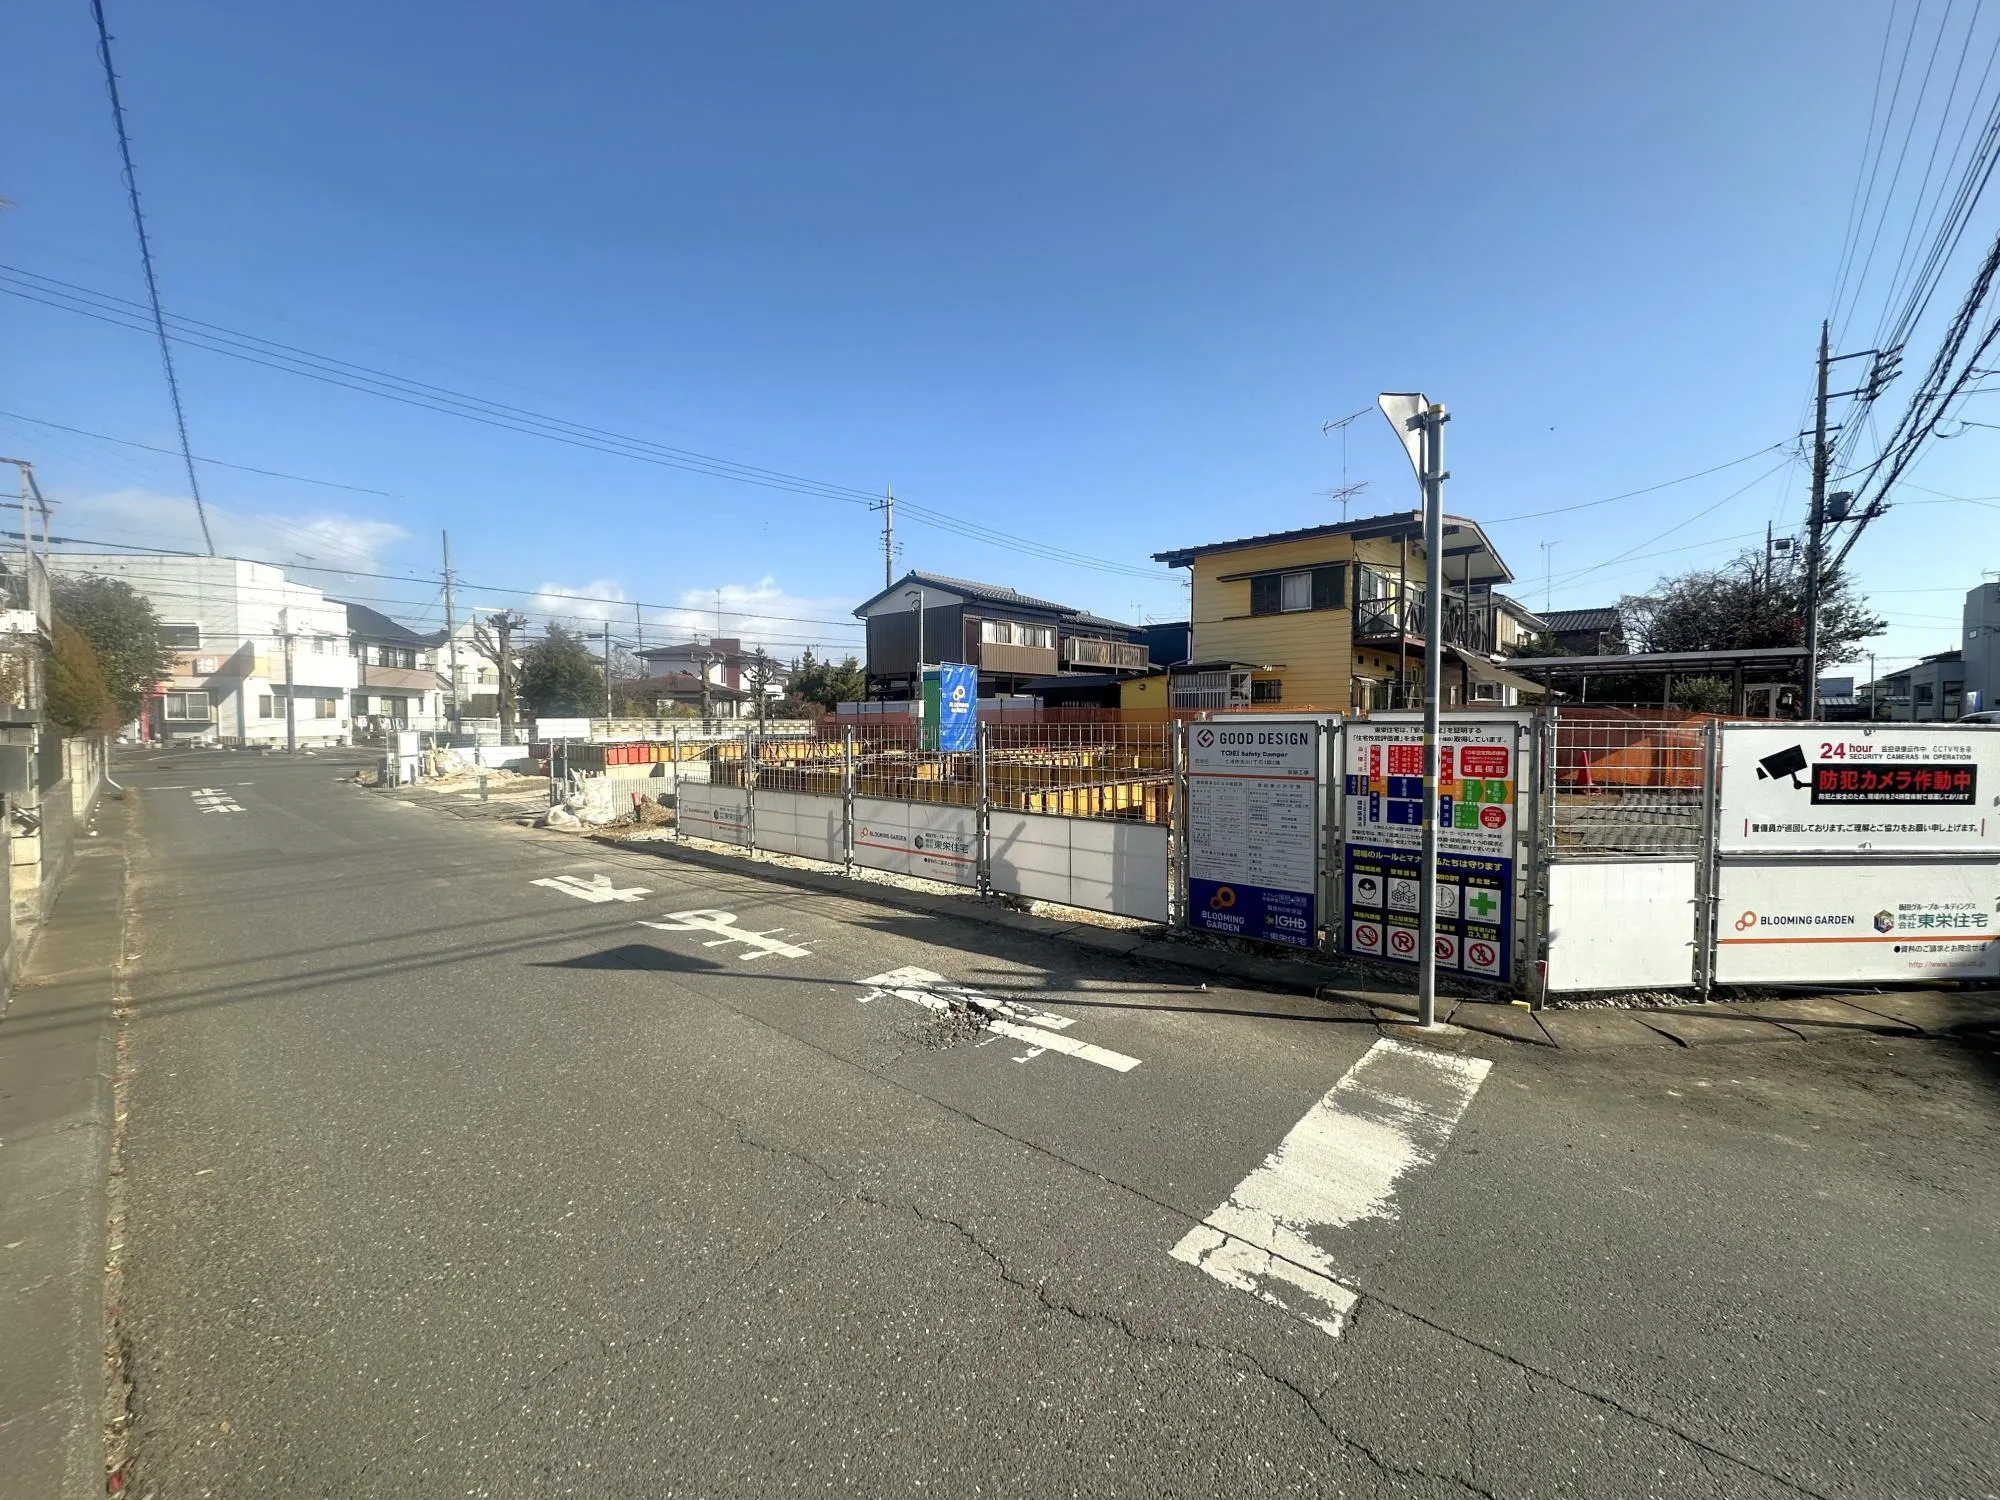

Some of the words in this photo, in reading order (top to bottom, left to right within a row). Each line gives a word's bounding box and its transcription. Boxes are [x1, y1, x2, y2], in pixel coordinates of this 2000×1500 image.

[1220, 732, 1253, 745] GOOD
[1258, 732, 1308, 745] DESIGN
[1820, 743, 1845, 759] 24
[1849, 743, 1873, 753] hour
[1819, 770, 1971, 791] 防犯カメラ作動中
[934, 840, 969, 854] 東栄住宅
[1202, 910, 1245, 925] BLOOMING
[1760, 915, 1813, 926] BLOOMING
[1814, 914, 1855, 925] GARDEN
[1917, 912, 1988, 929] 東栄住宅
[1206, 920, 1240, 933] GARDEN
